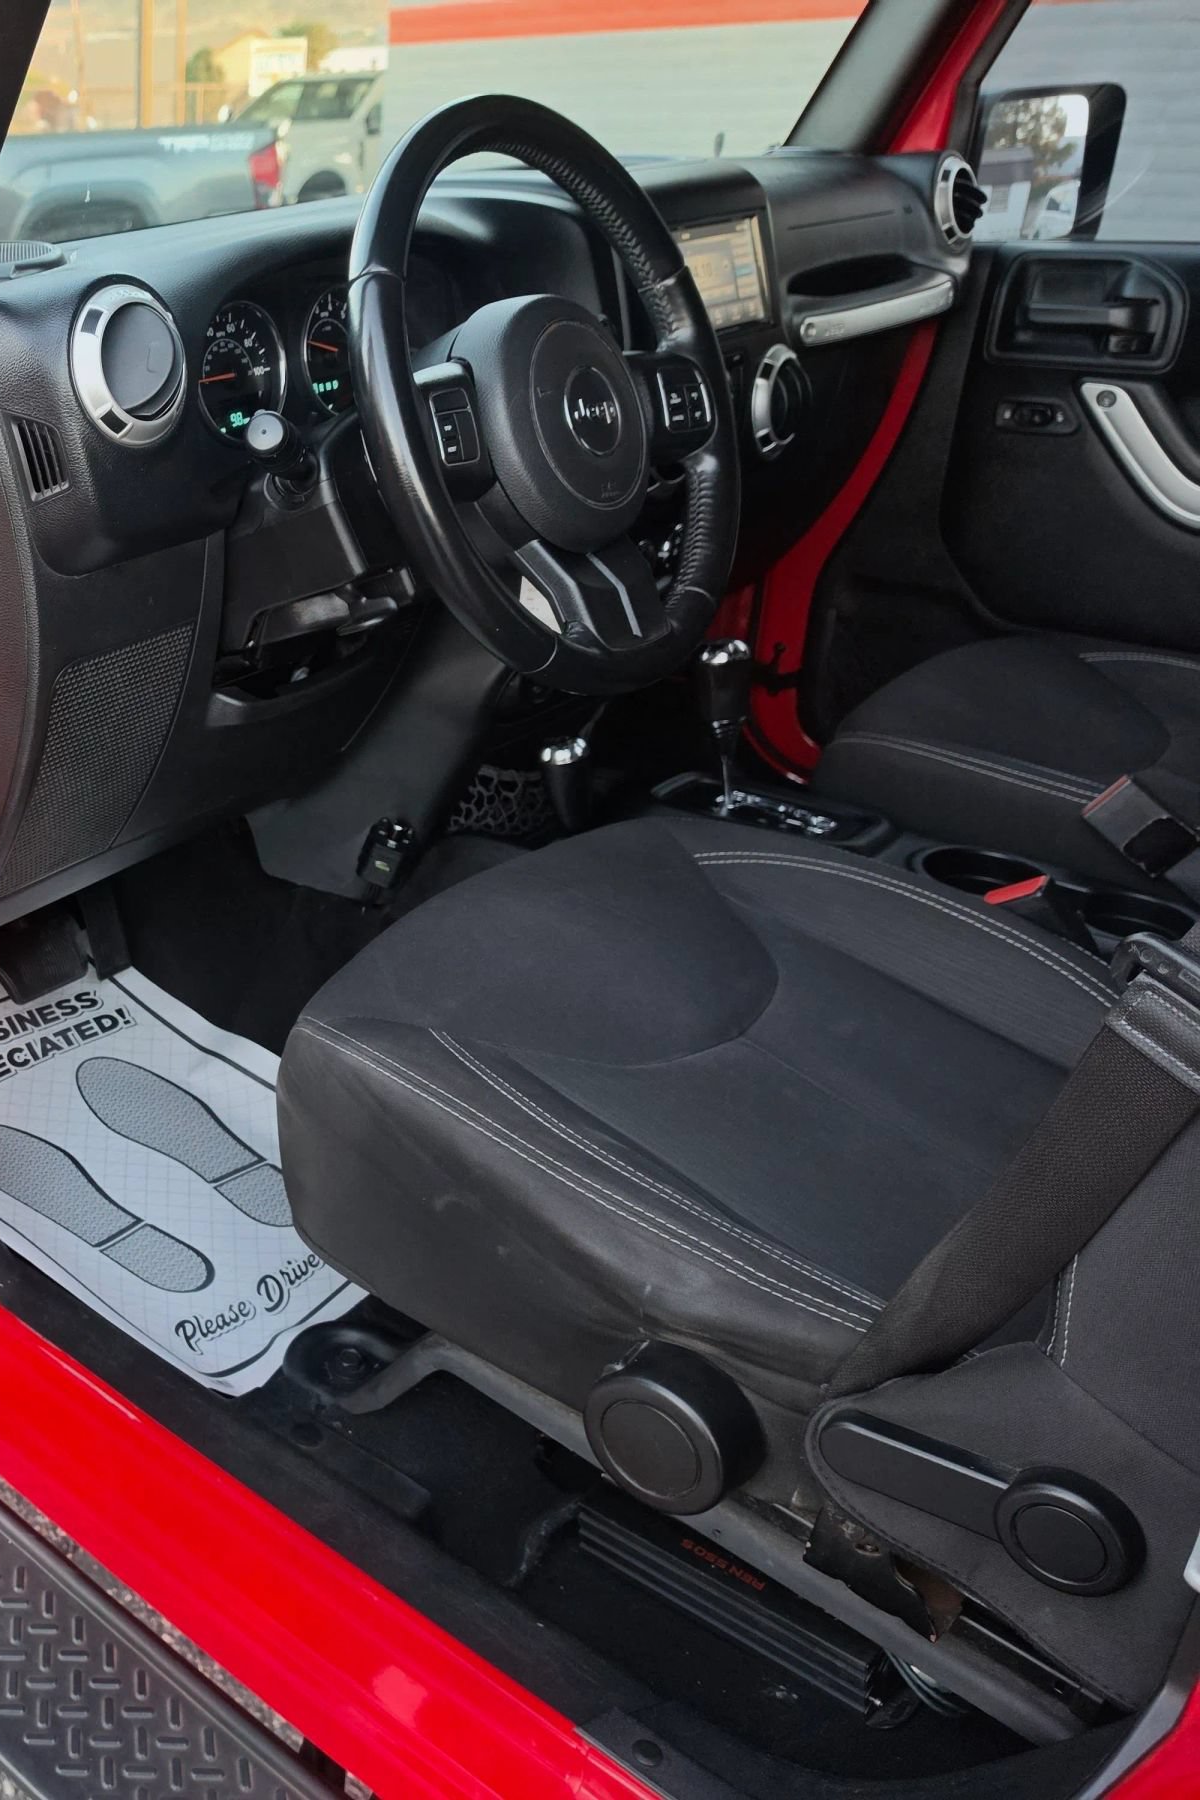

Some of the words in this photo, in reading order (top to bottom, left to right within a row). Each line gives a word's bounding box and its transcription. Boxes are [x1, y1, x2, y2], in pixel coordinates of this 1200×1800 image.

[573, 398, 617, 424] Jeep
[174, 1300, 251, 1353] Please
[256, 1253, 321, 1313] Drive
